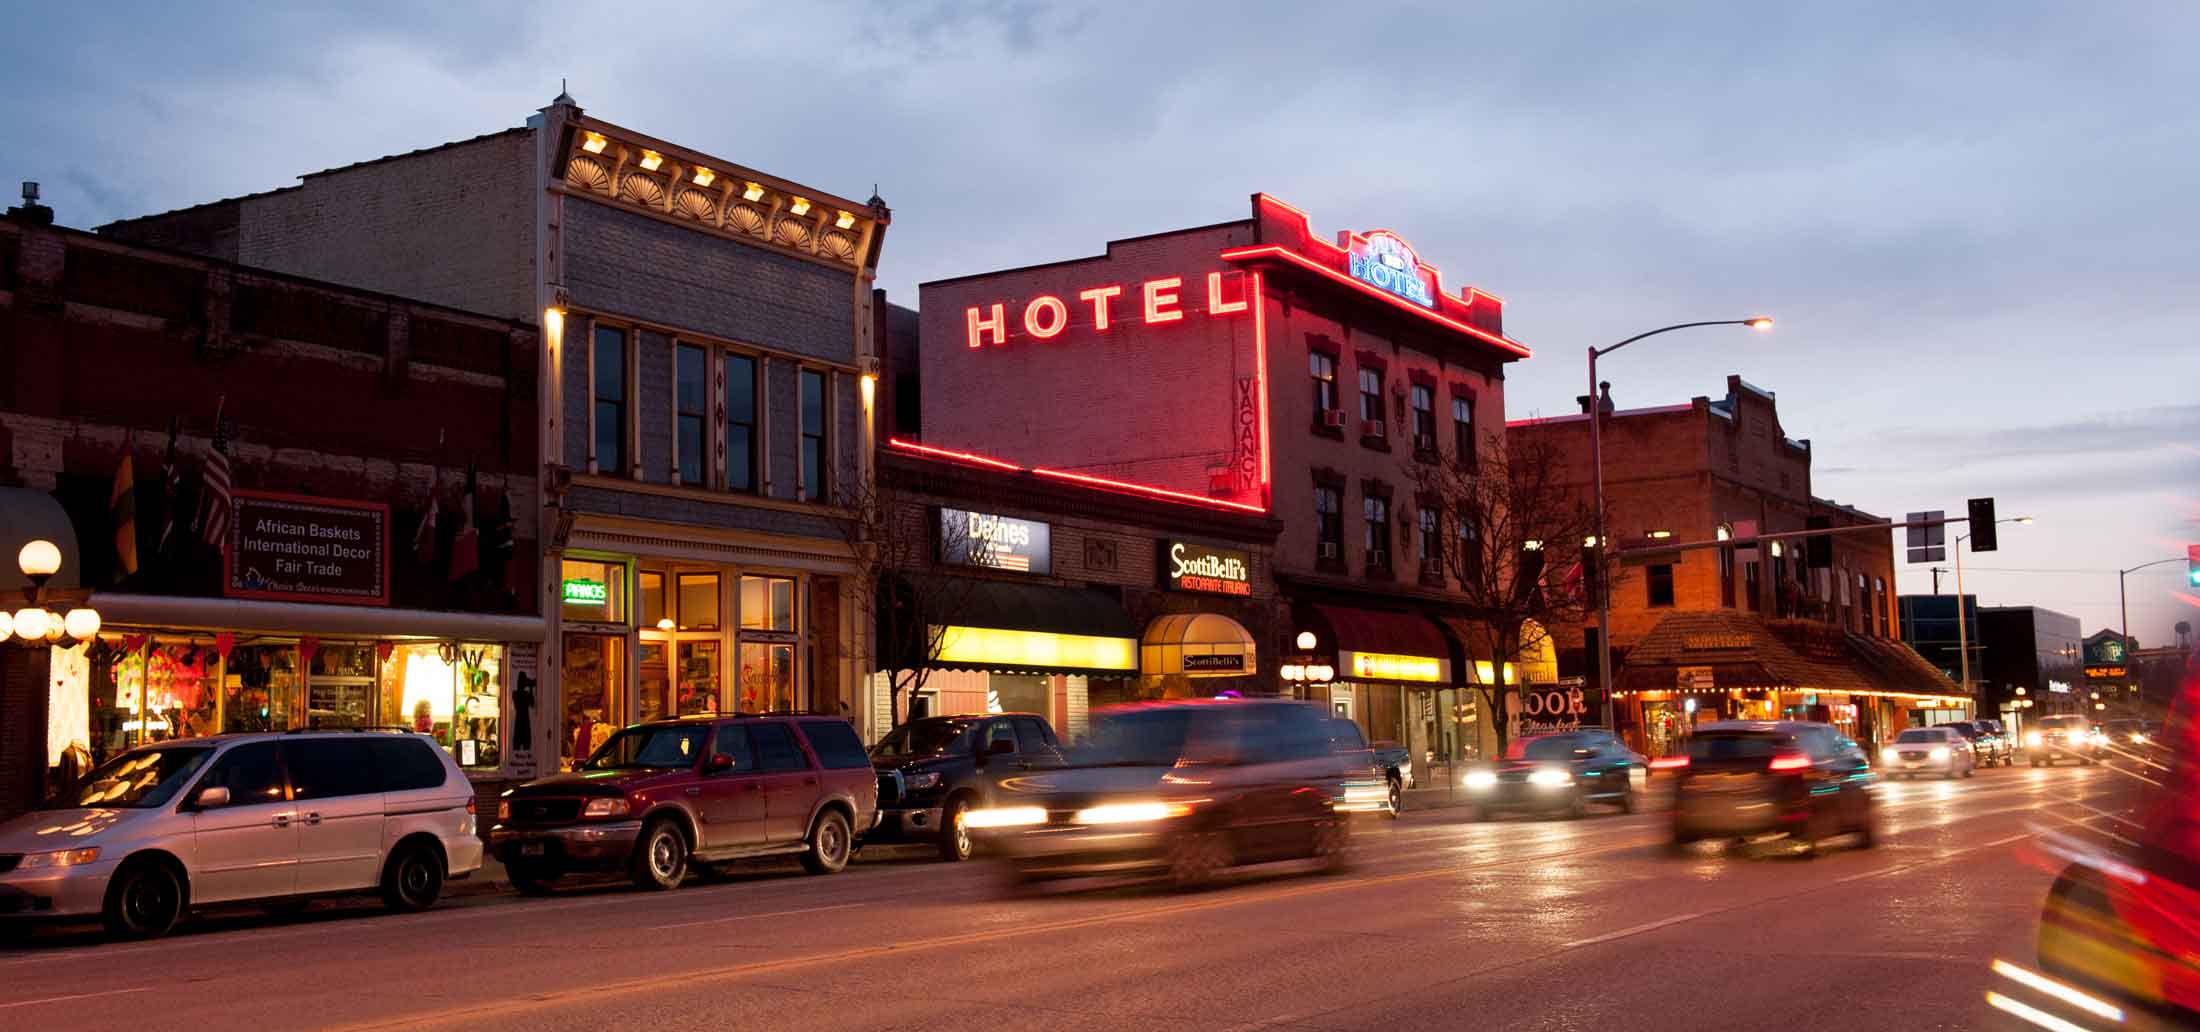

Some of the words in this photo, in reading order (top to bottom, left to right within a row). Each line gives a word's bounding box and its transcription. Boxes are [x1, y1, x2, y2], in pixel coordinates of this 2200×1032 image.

[1350, 251, 1433, 306] HOTEL
[966, 270, 1249, 349] HOTEL
[1238, 377, 1255, 489] VACANCY
[255, 519, 306, 537] African
[309, 523, 361, 541] Baskets
[968, 511, 1030, 545] Daines
[243, 536, 329, 557] International
[333, 545, 372, 560] Decor
[1171, 543, 1246, 581] ScottiBelli's
[275, 558, 303, 574] Fair
[306, 561, 342, 577] Trade
[565, 582, 606, 598] PIANOS
[1181, 576, 1222, 592] RISTORANTE
